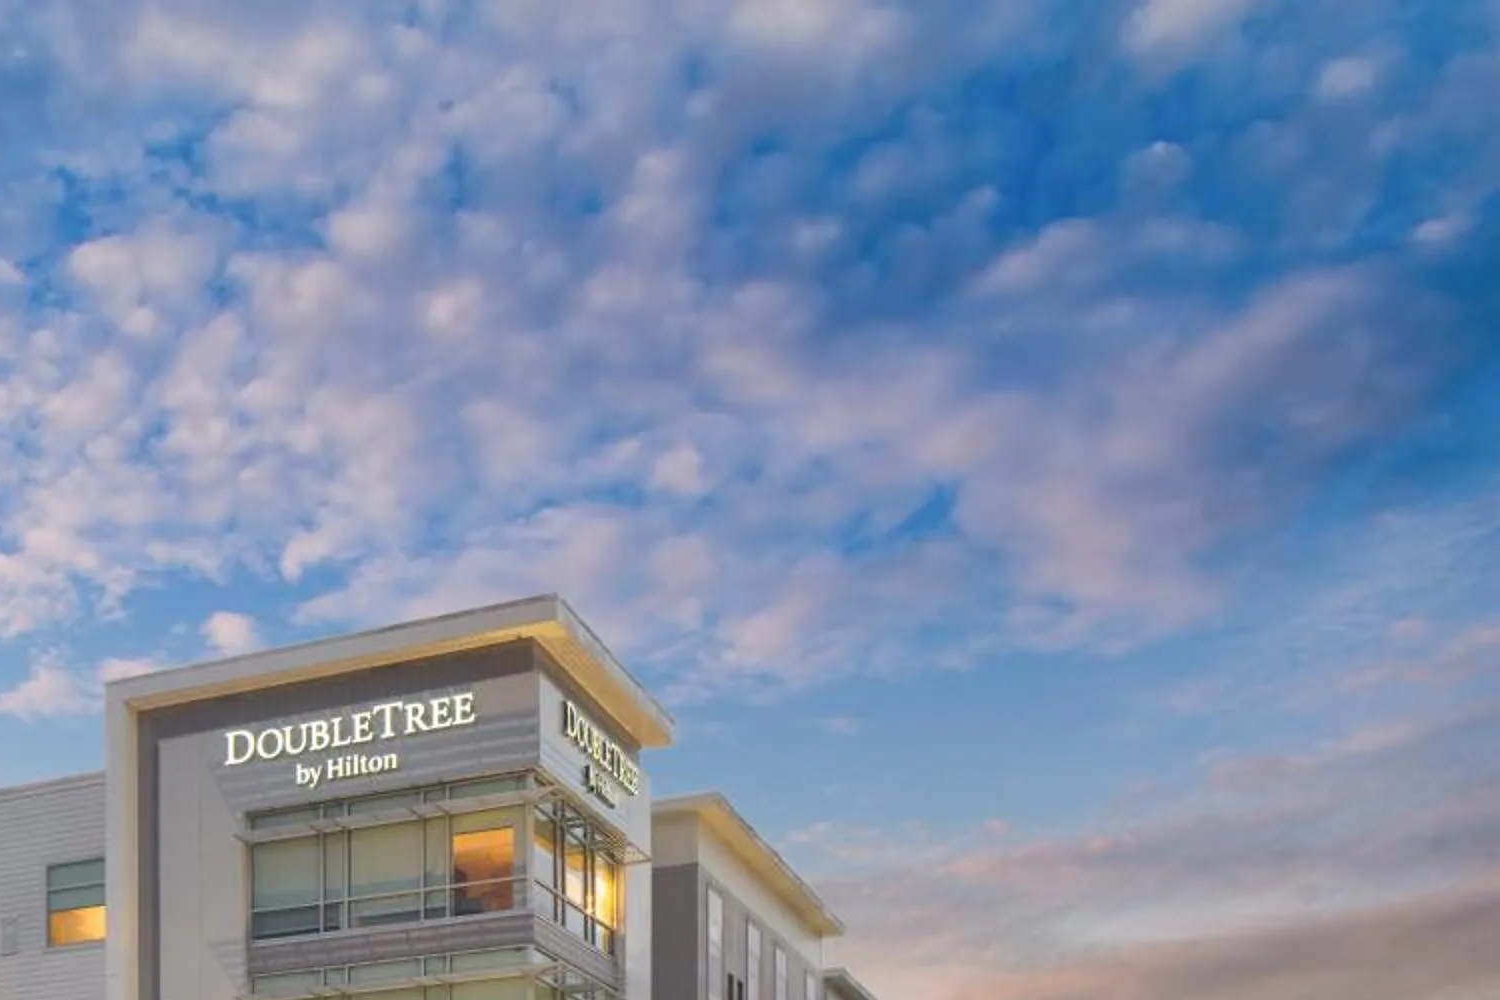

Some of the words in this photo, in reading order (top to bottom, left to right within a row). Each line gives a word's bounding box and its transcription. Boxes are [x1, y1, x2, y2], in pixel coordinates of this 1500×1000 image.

[224, 692, 476, 766] DOUBLETREE
[296, 764, 323, 788] by
[327, 753, 398, 780] Hilton
